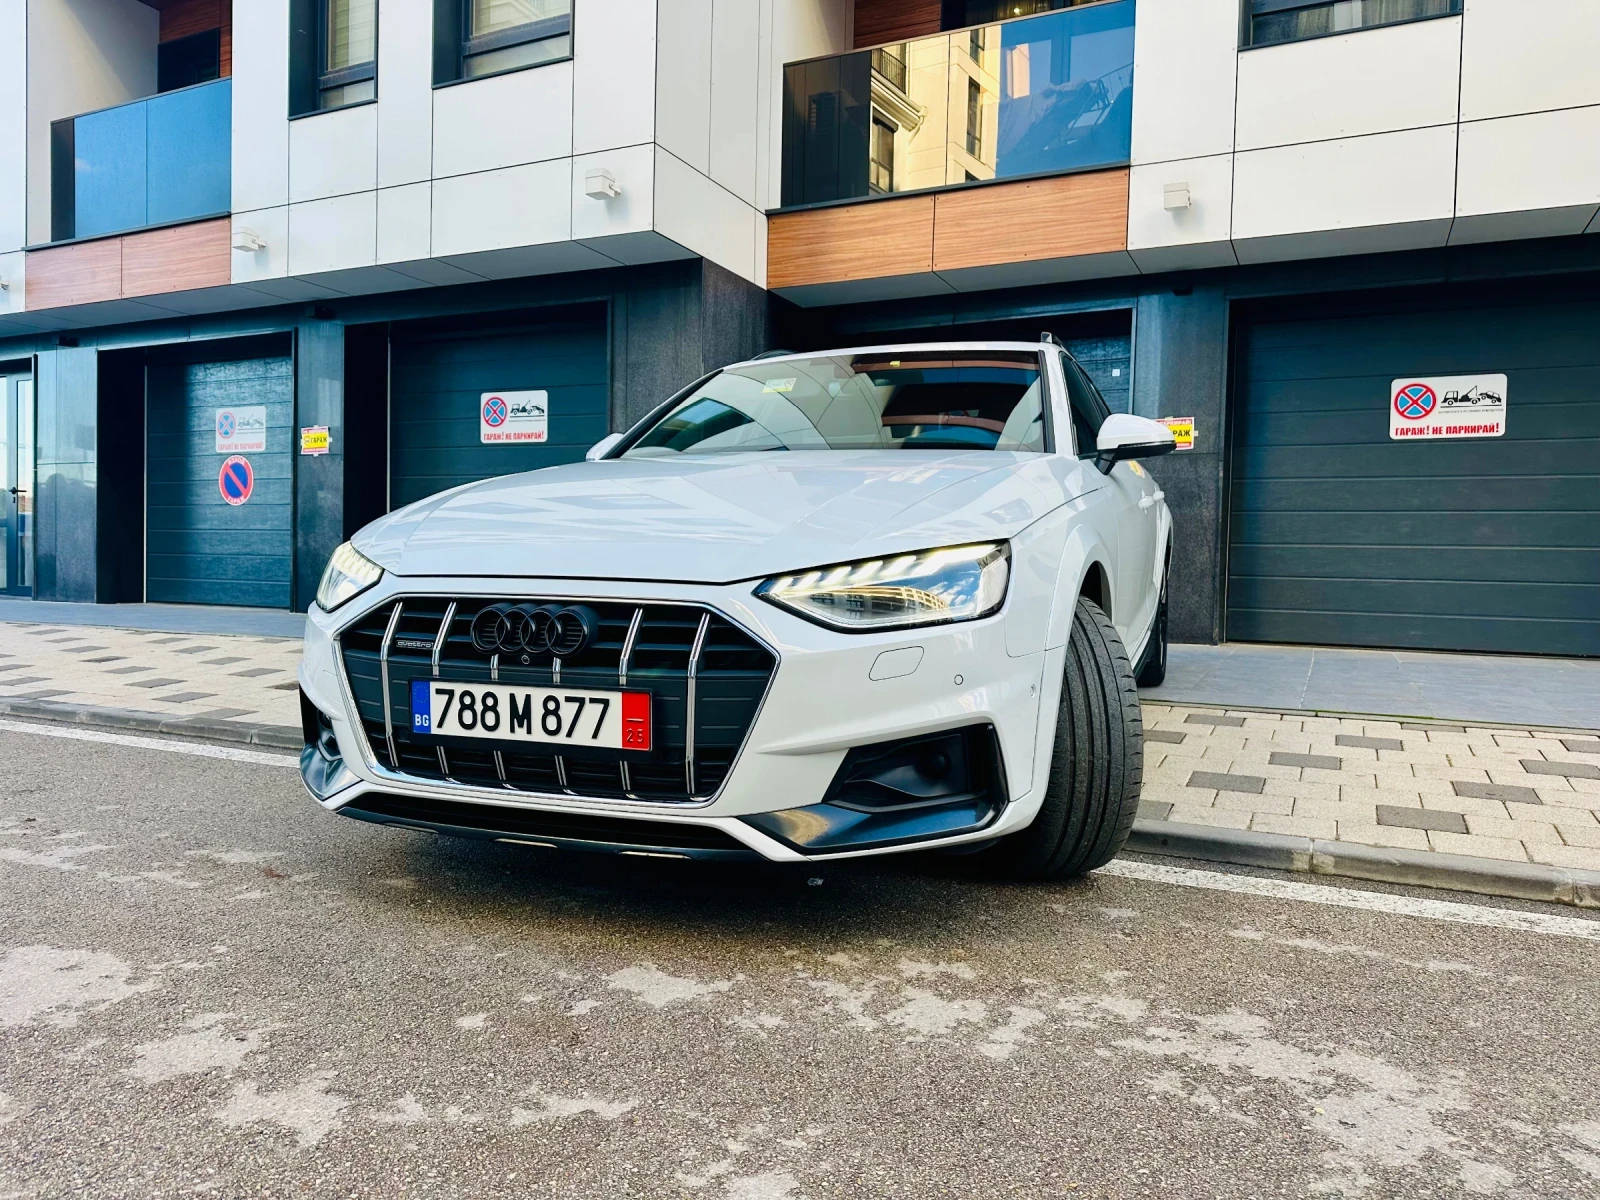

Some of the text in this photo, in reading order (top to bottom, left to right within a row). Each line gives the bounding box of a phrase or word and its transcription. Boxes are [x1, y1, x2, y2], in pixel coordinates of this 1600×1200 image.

[1172, 429, 1191, 437] РАЖ
[1395, 422, 1499, 436] ГАРАЖ! НЕ ПАРКИРАЙ!
[310, 436, 328, 444] ГАРАЖ
[484, 432, 504, 441] ГАРАЖ!
[513, 431, 544, 440] ПАРКИРАЙ!
[414, 713, 429, 727] BG
[435, 688, 610, 740] 788 M 877
